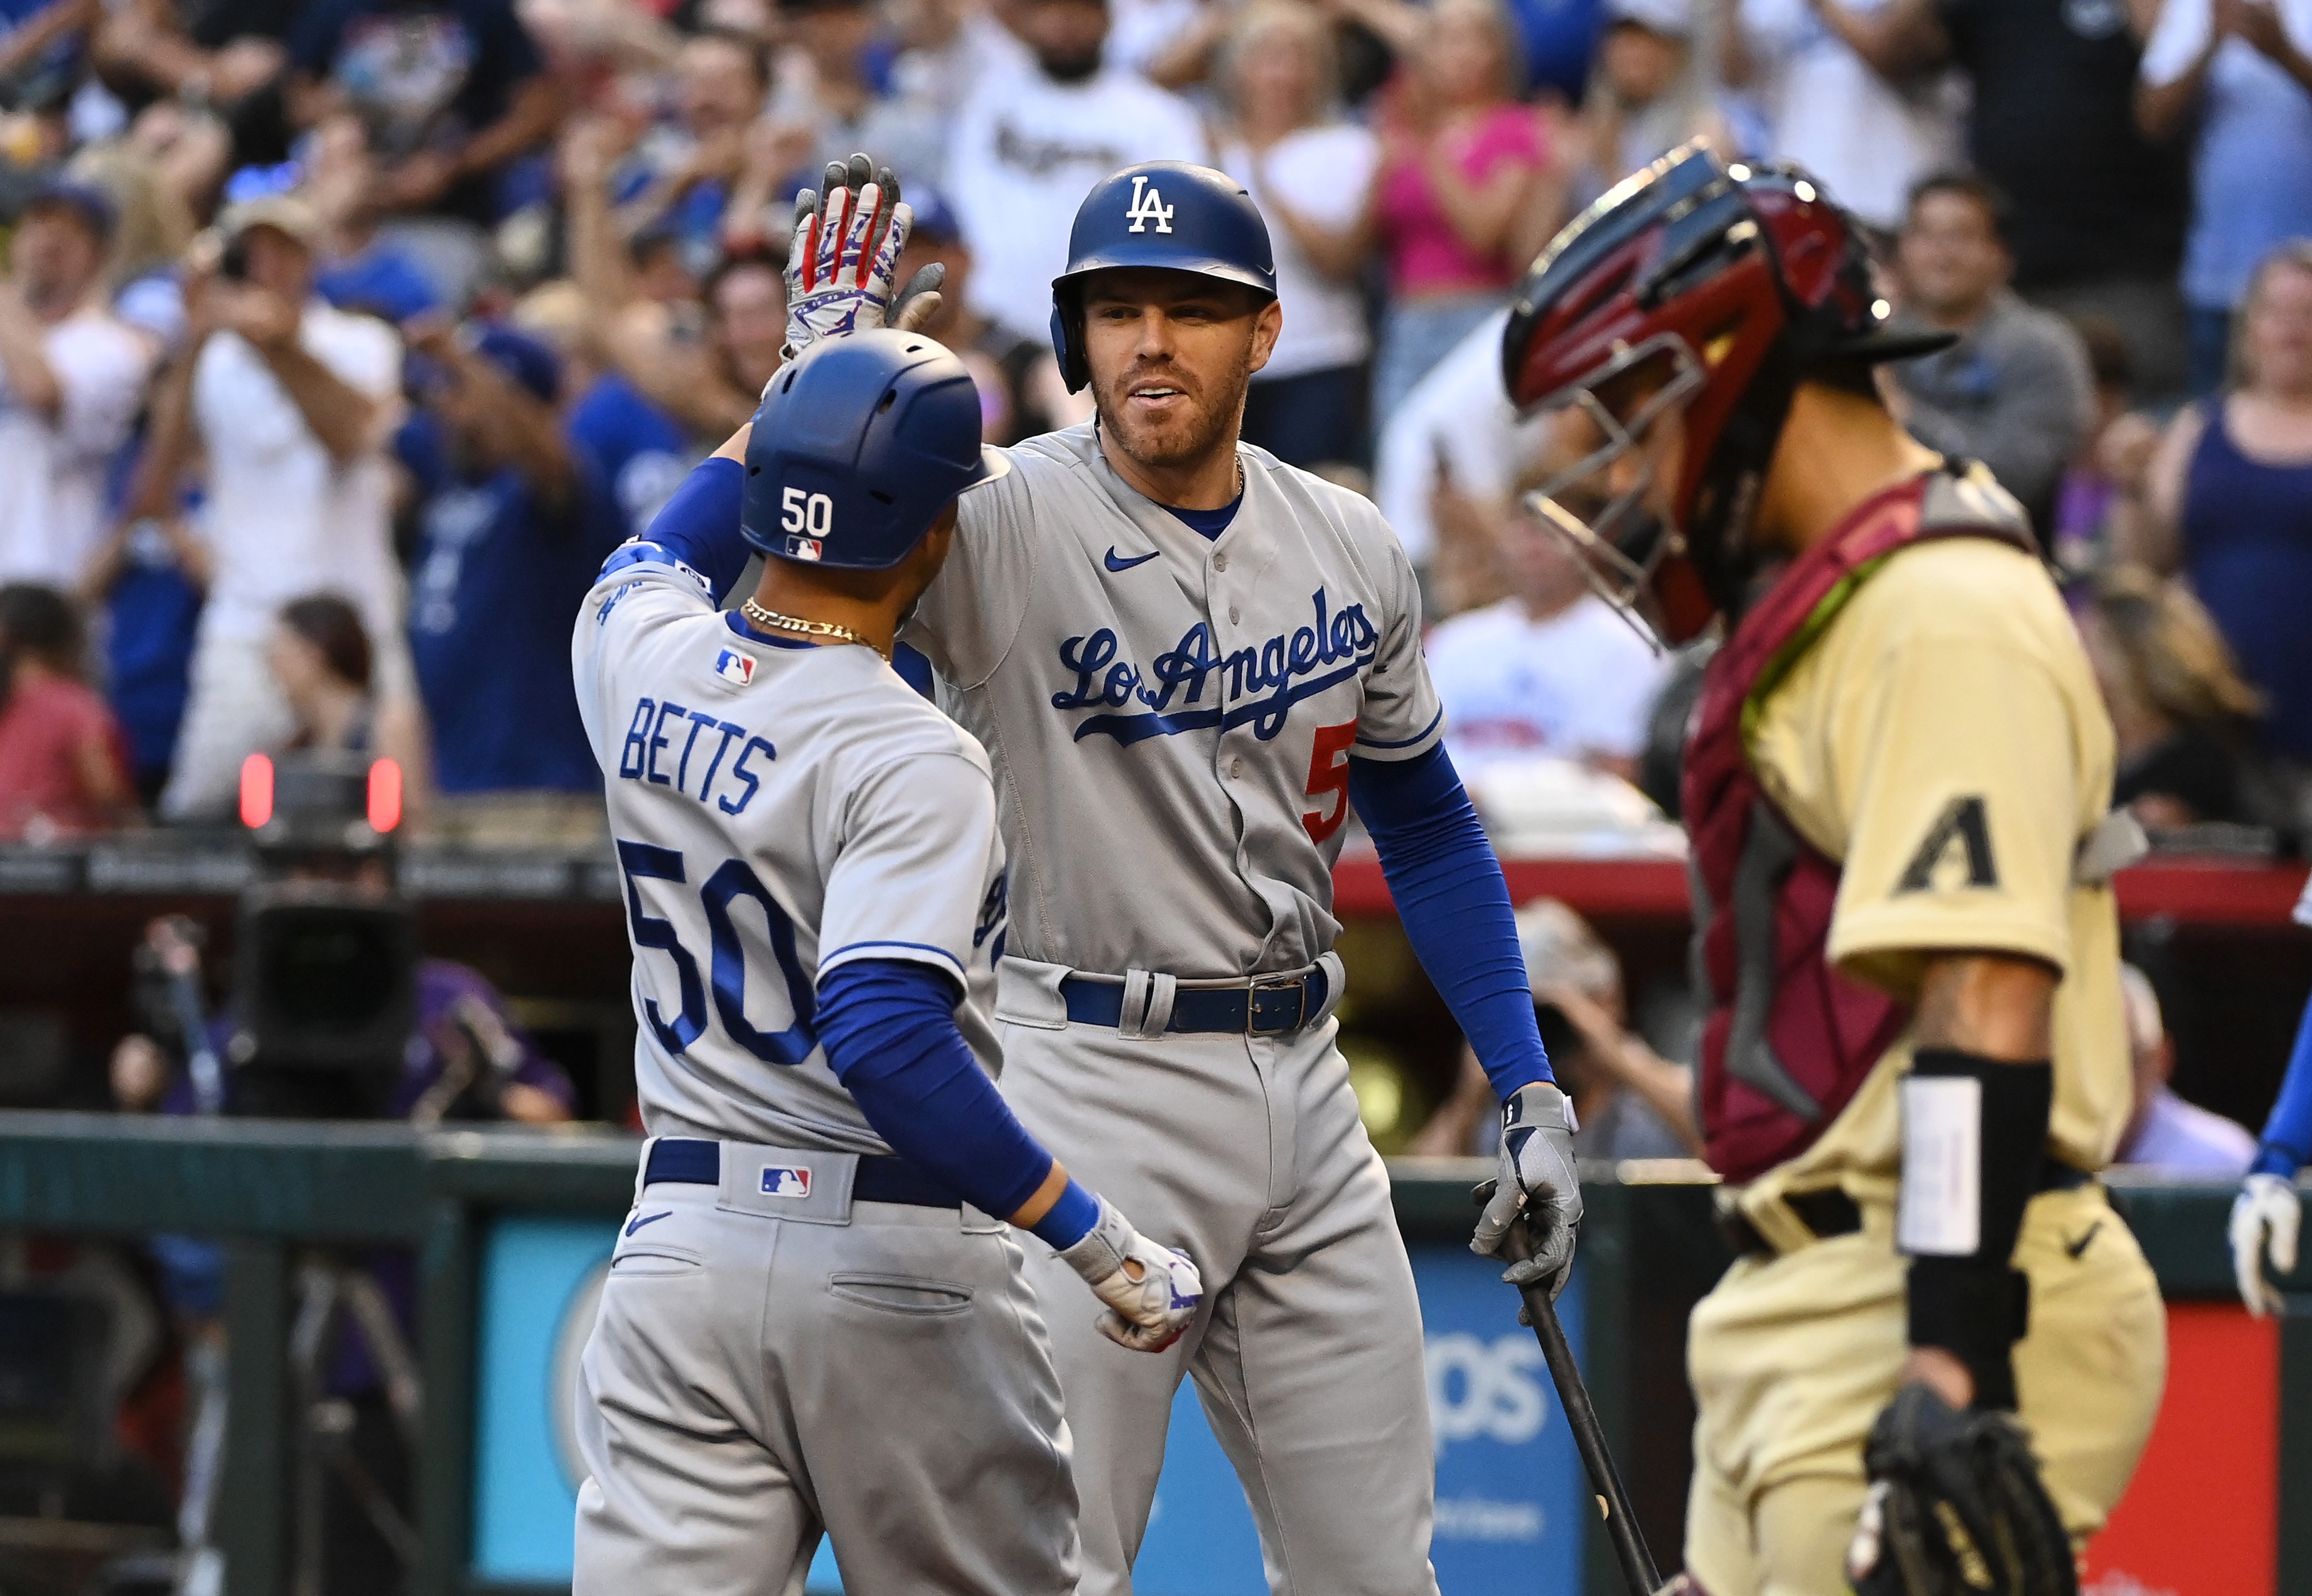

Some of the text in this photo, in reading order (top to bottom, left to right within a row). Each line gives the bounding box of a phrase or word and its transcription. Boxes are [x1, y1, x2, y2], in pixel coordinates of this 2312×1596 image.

[1126, 176, 1174, 234] LA
[781, 486, 833, 538] 50
[1148, 585, 1379, 741] Angeles
[620, 697, 777, 815] BETTS
[1302, 717, 1358, 846] 5
[1890, 796, 1998, 894] A
[616, 838, 820, 1065] 50
